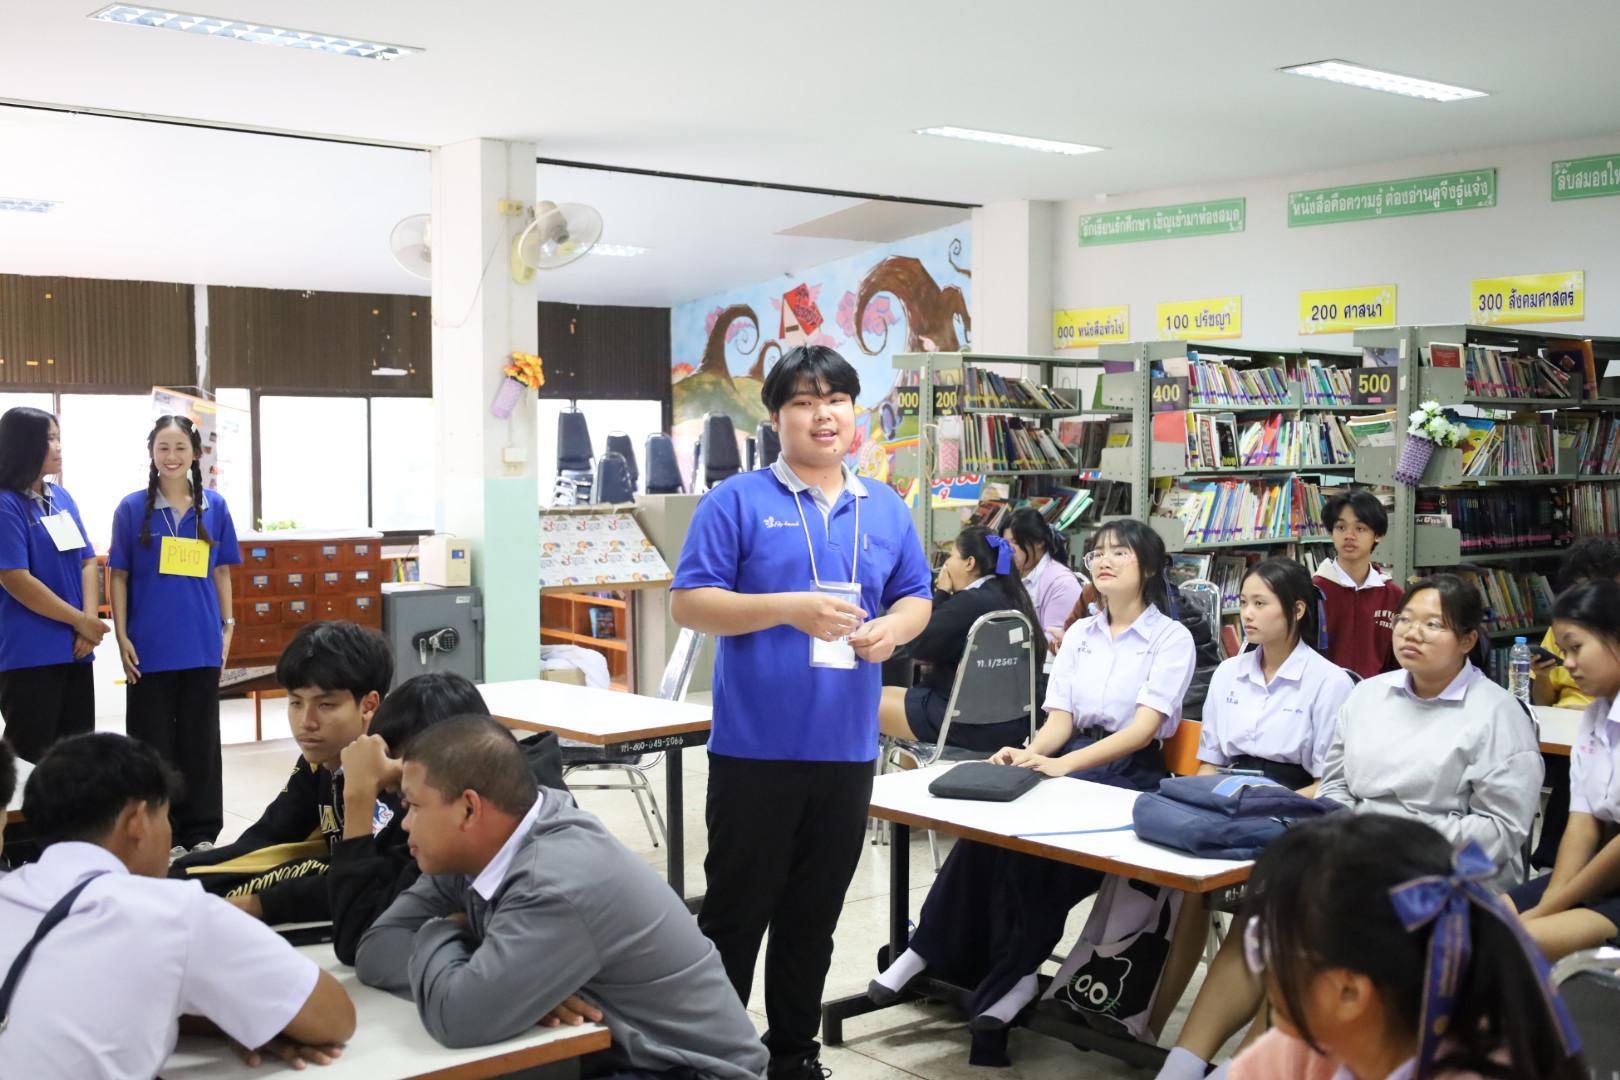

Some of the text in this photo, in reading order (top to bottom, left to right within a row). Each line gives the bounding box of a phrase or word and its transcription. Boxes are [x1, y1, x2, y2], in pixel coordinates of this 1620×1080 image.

[1478, 283, 1574, 311] 300 สังคมศาสตร์
[1166, 309, 1231, 330] 100 ปรัชญา
[1311, 303, 1382, 321] 200 ศาสนา
[1057, 315, 1124, 339] 000 หนังสือทั่วไป
[1153, 384, 1180, 402] 400
[1359, 373, 1391, 394] 500
[936, 391, 957, 408] 200
